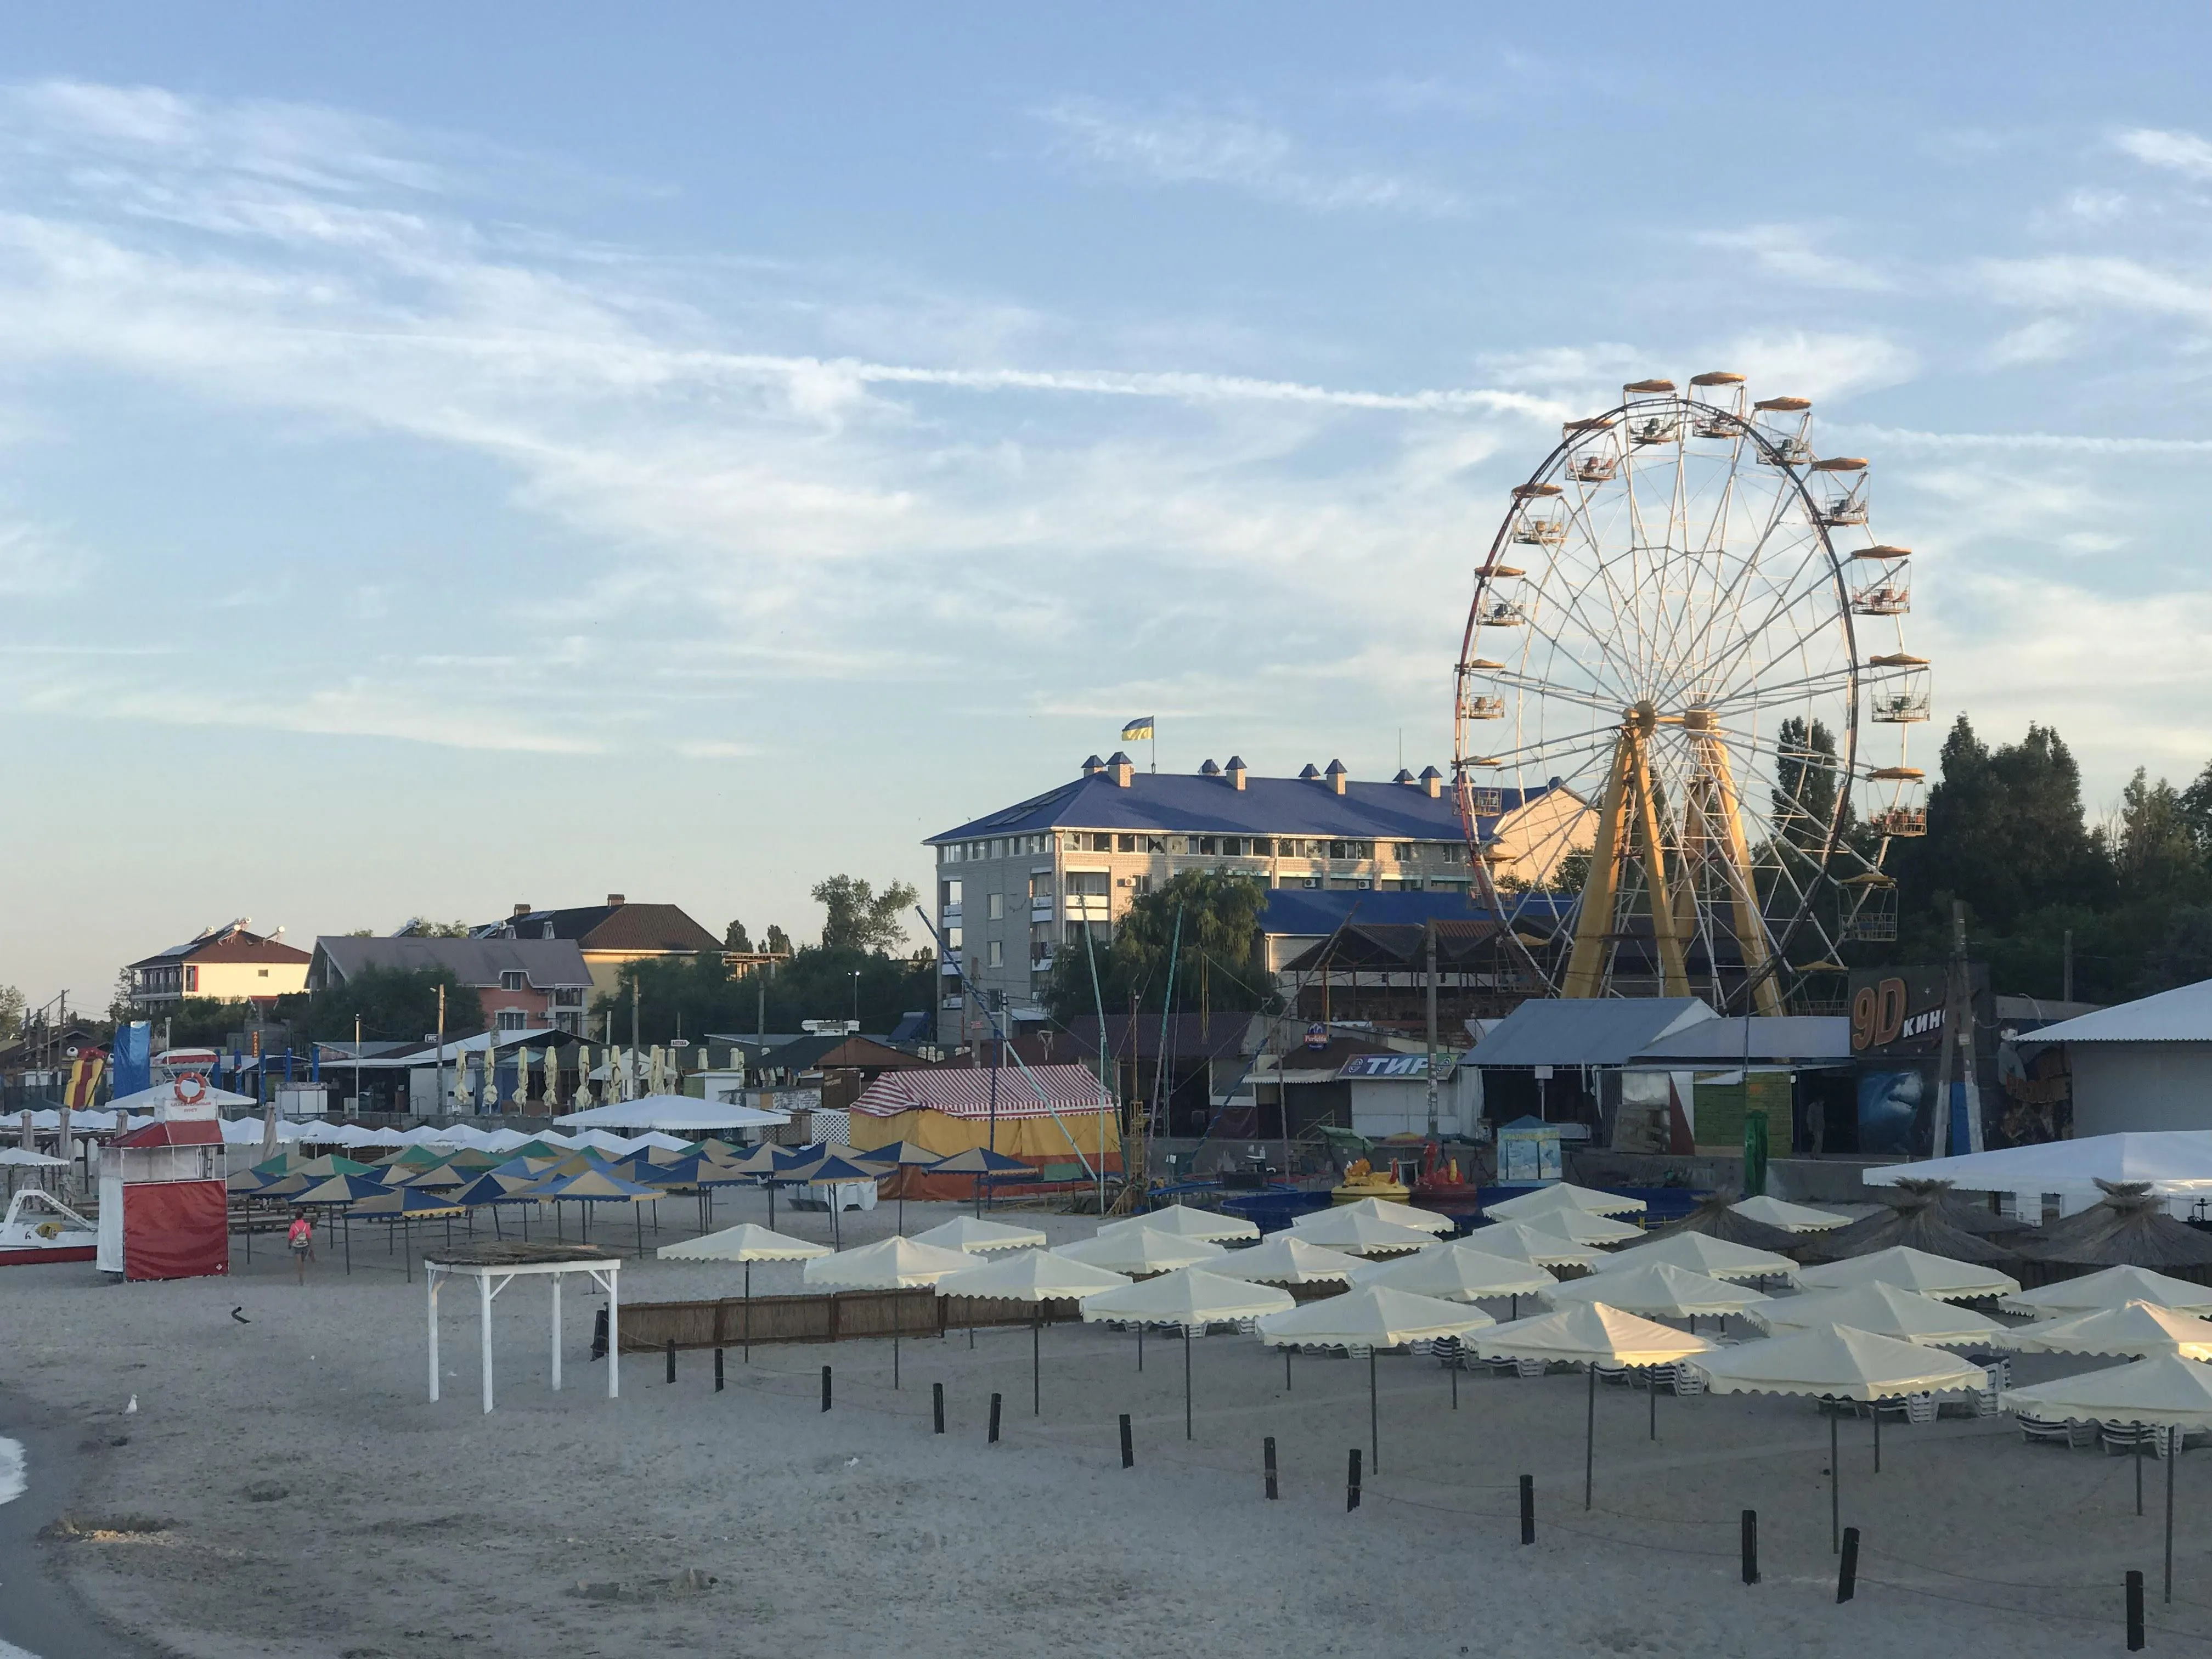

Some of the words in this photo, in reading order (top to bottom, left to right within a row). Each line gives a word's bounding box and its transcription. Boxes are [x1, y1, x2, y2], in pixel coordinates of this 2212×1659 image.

[1853, 978, 1906, 1050] 9D
[1367, 1058, 1428, 1074] ТИР
[25, 1231, 31, 1240] 6
